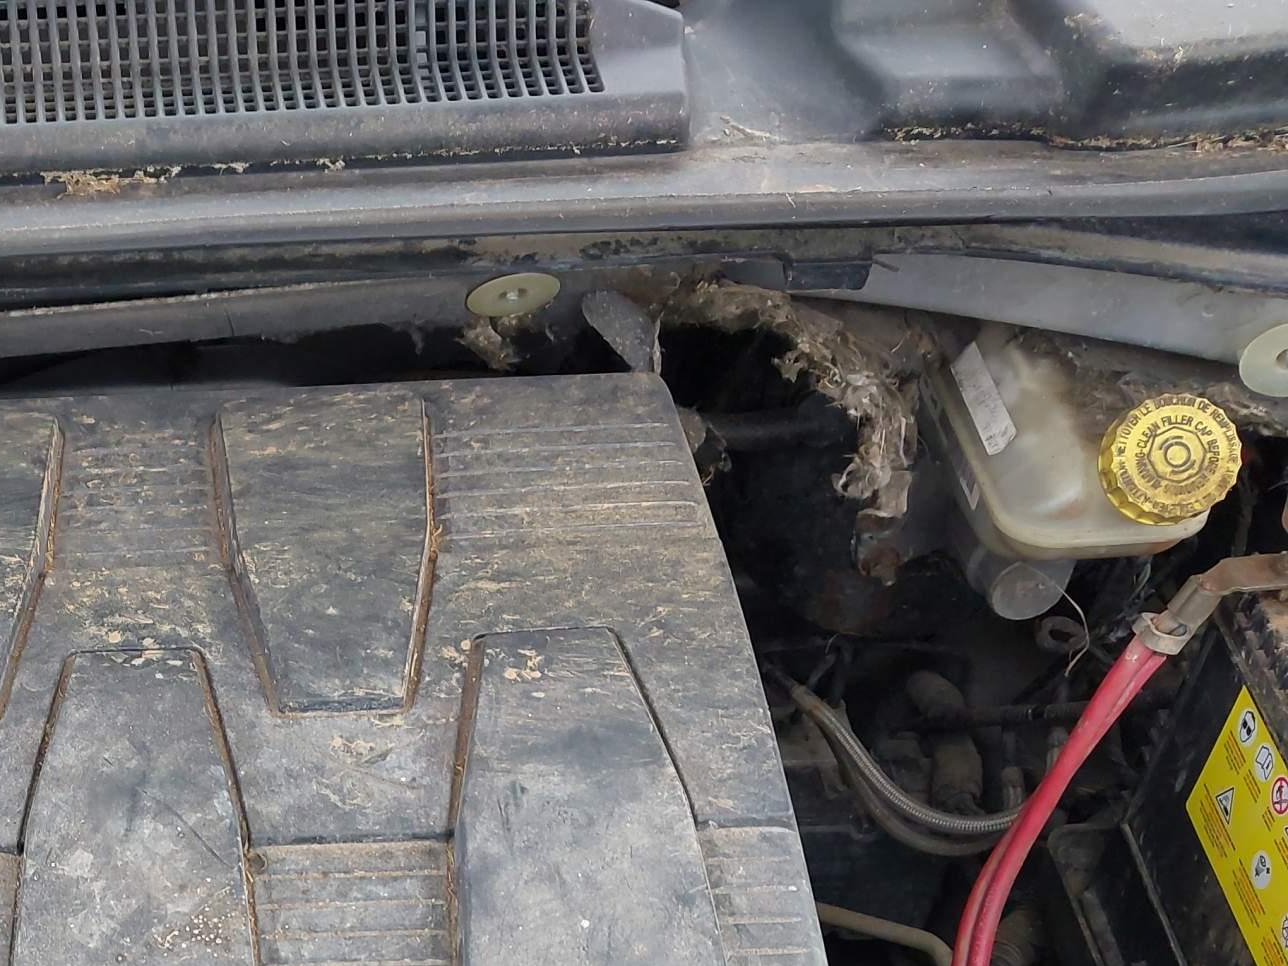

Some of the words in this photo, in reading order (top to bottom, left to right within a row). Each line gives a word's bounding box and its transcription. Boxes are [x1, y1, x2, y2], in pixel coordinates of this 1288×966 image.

[1197, 399, 1211, 413] DE
[1162, 414, 1194, 427] FILLER
[1195, 420, 1212, 437] CAP
